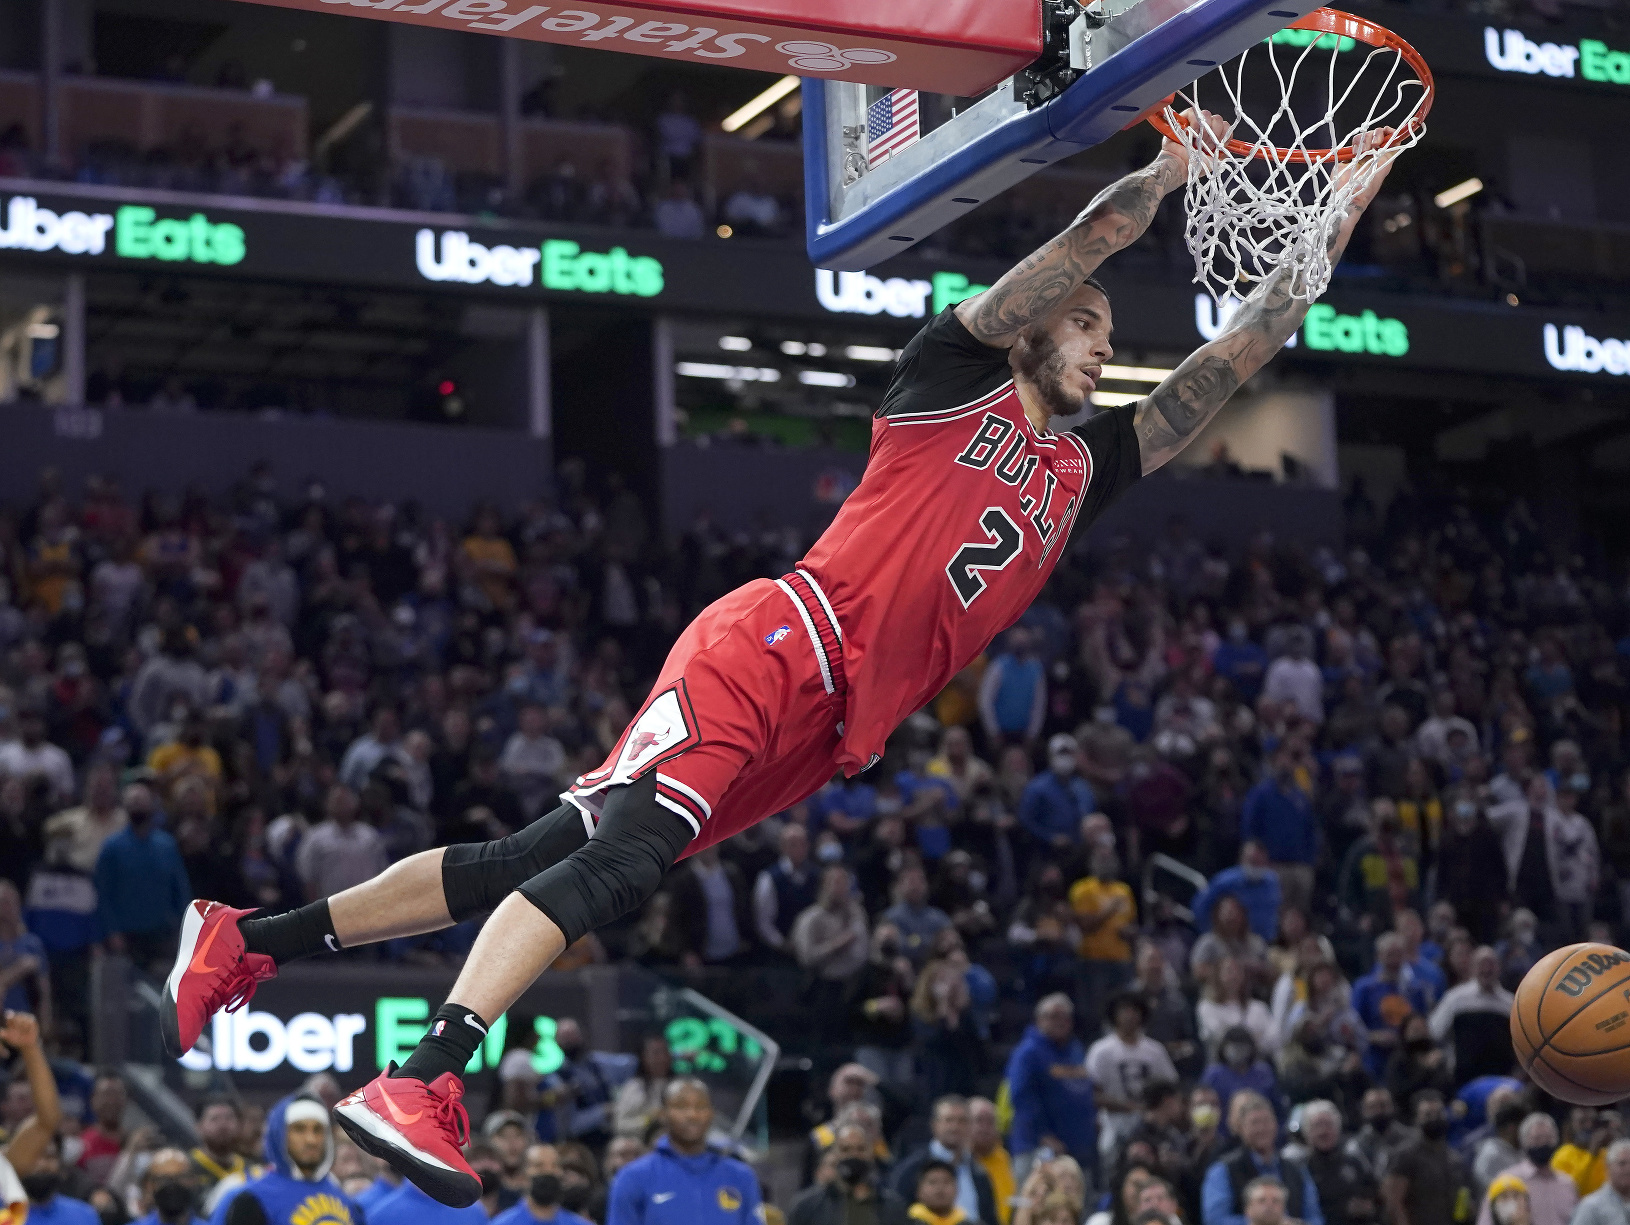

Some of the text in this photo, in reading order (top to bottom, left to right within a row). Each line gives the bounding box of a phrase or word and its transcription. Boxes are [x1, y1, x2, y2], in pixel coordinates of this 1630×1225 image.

[1484, 26, 1579, 78] Uber
[115, 205, 246, 265] Eats
[416, 228, 664, 297] Uber Eats
[815, 267, 932, 318] Uber
[1303, 303, 1410, 357] Eats
[1543, 322, 1630, 376] Ube
[945, 506, 1024, 611] 2
